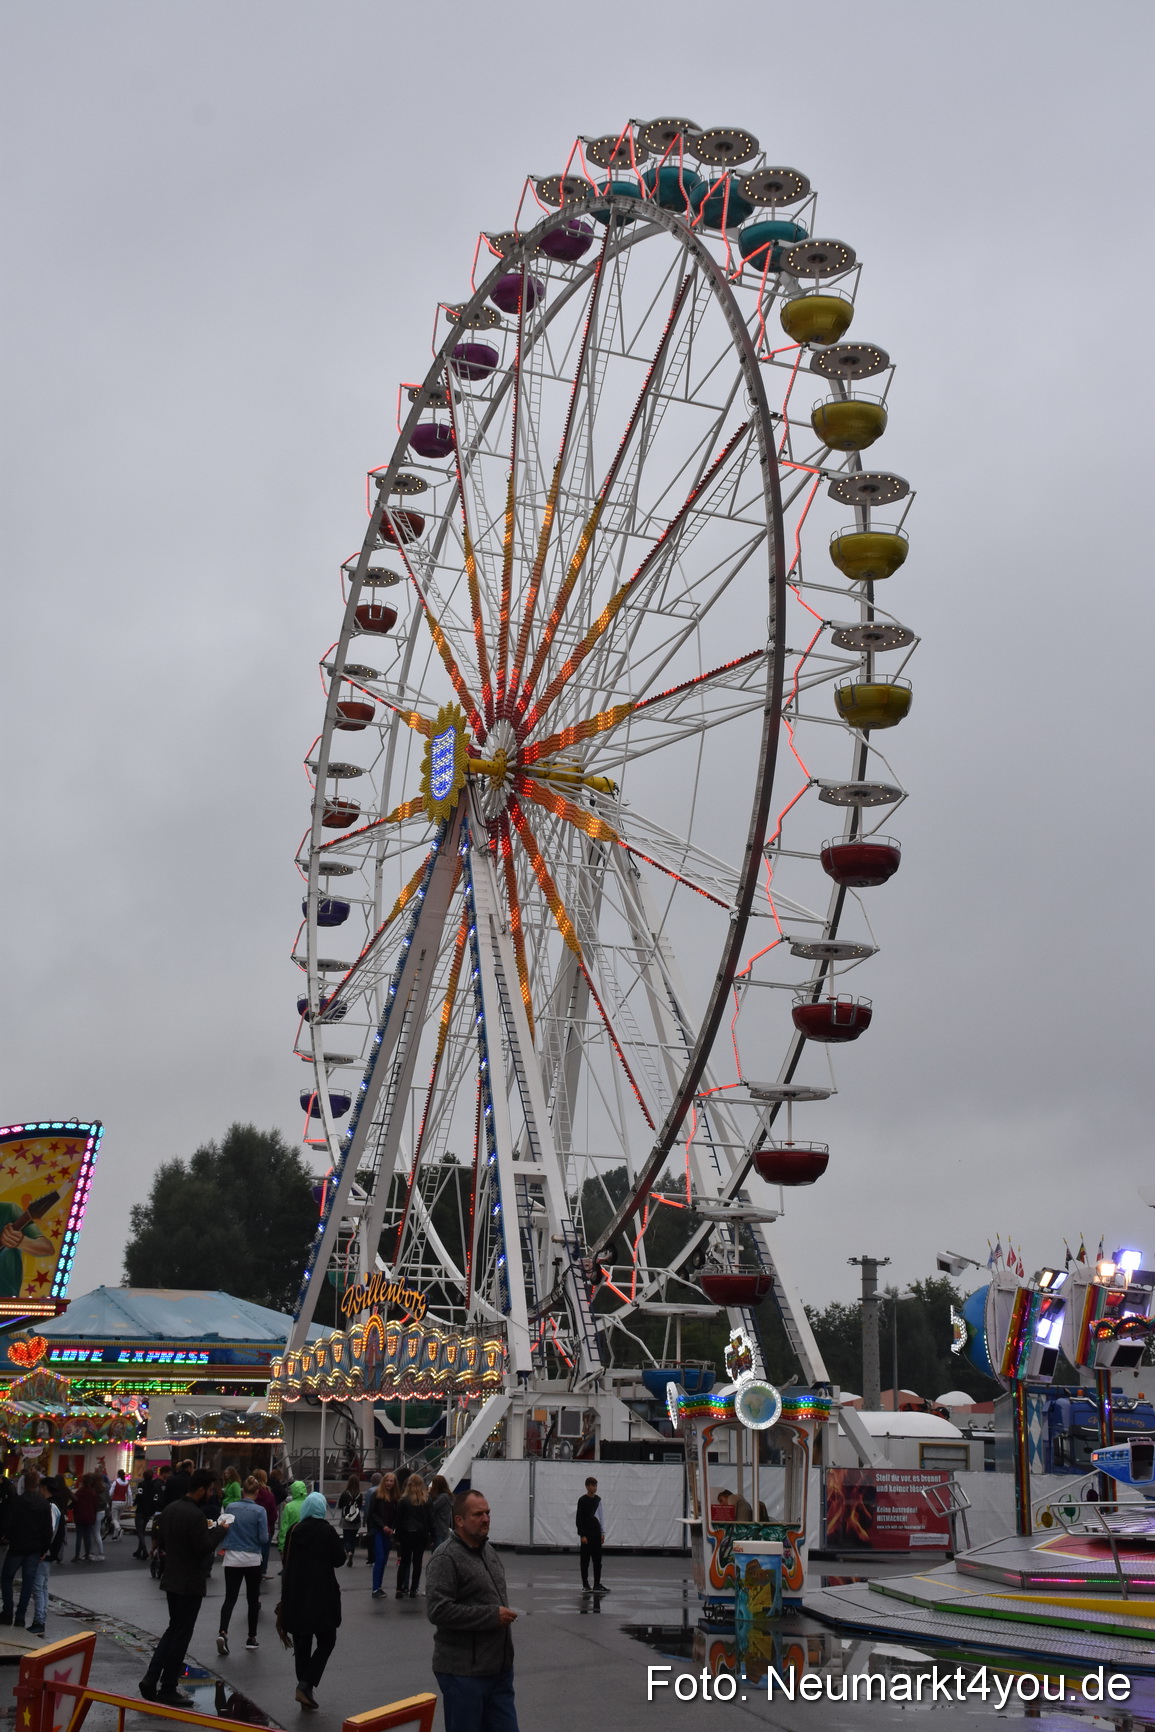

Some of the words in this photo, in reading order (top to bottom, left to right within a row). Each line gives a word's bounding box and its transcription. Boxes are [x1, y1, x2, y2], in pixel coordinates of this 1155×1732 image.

[341, 1271, 428, 1321] Willenborg
[49, 1348, 104, 1361] LOVE
[117, 1350, 210, 1364] EXPRESS
[876, 1473, 890, 1482] Stell
[891, 1474, 900, 1482] dir
[912, 1475, 920, 1483] es
[921, 1474, 941, 1483] brennt
[876, 1485, 888, 1493] und
[889, 1485, 909, 1493] keiner
[892, 1506, 918, 1514] Ausreden!
